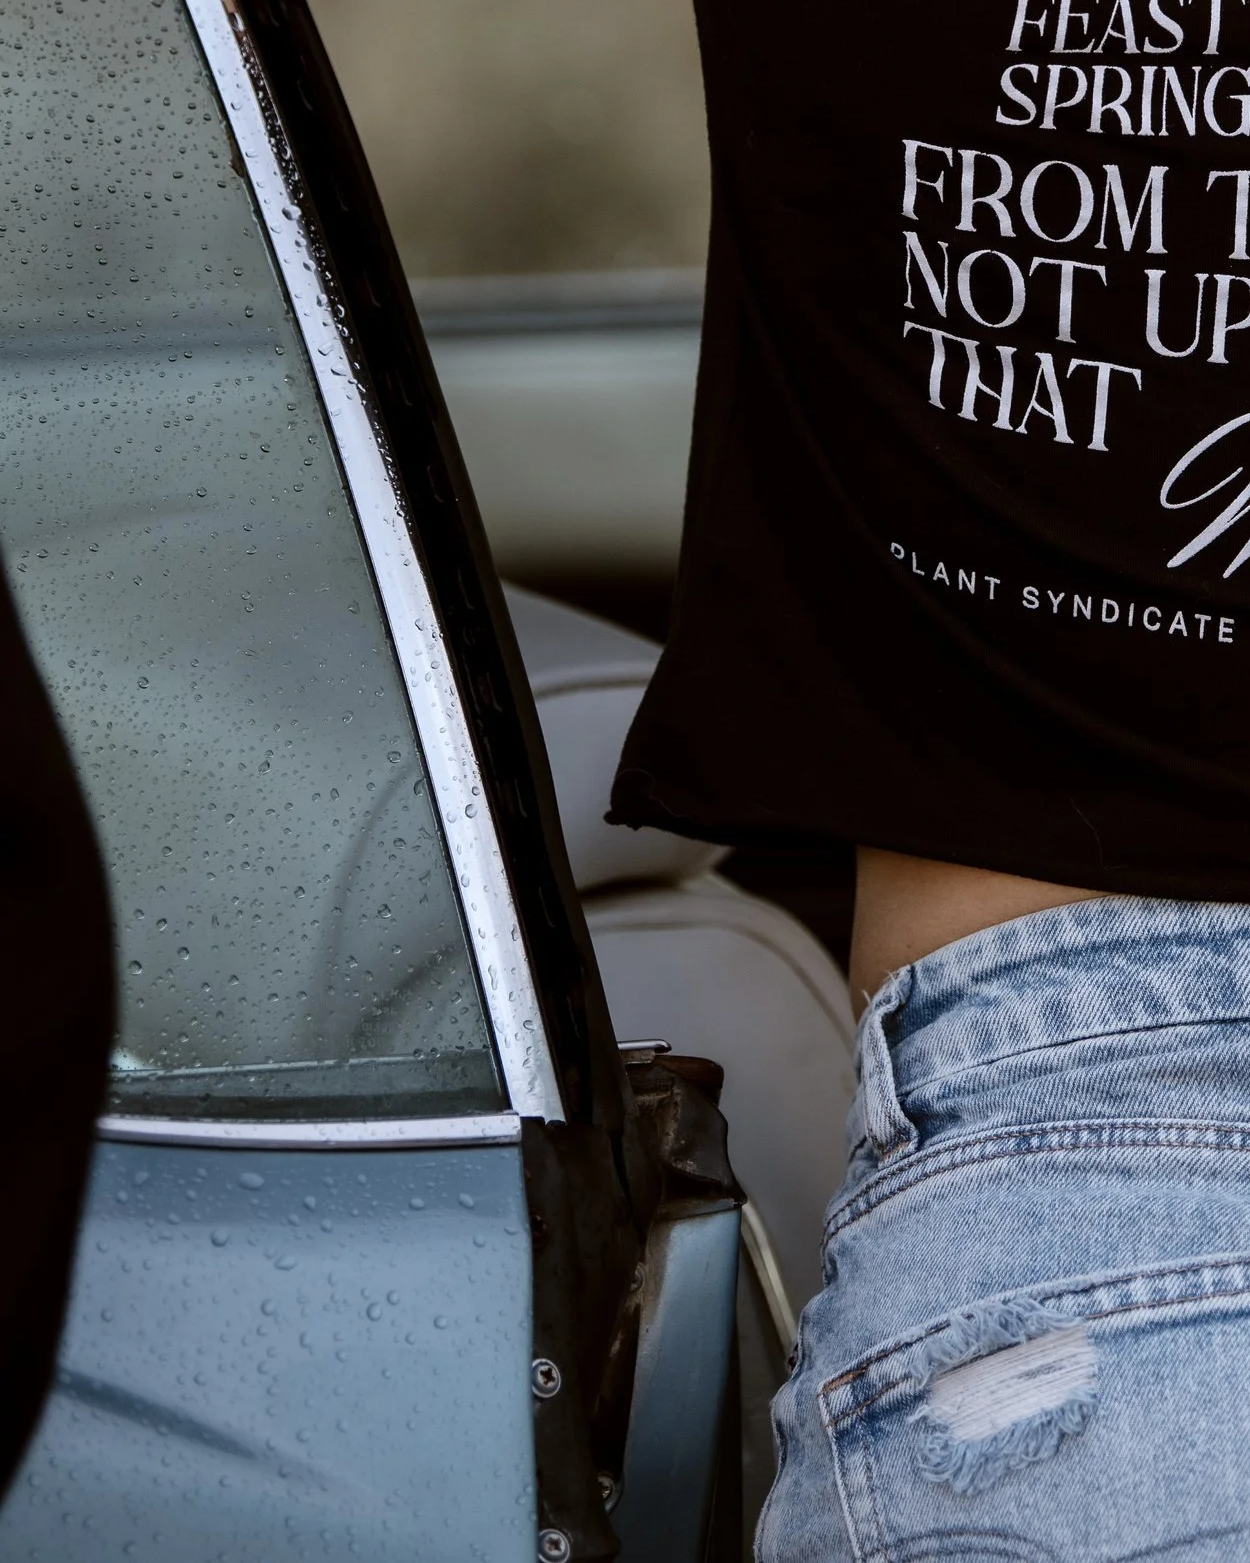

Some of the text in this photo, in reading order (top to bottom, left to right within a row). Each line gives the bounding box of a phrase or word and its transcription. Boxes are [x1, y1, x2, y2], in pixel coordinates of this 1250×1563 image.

[901, 140, 1169, 253] FROM
[903, 231, 1107, 343] NOT
[904, 321, 1141, 451] THAT
[891, 543, 1234, 643] PLANT SYNDICATE
